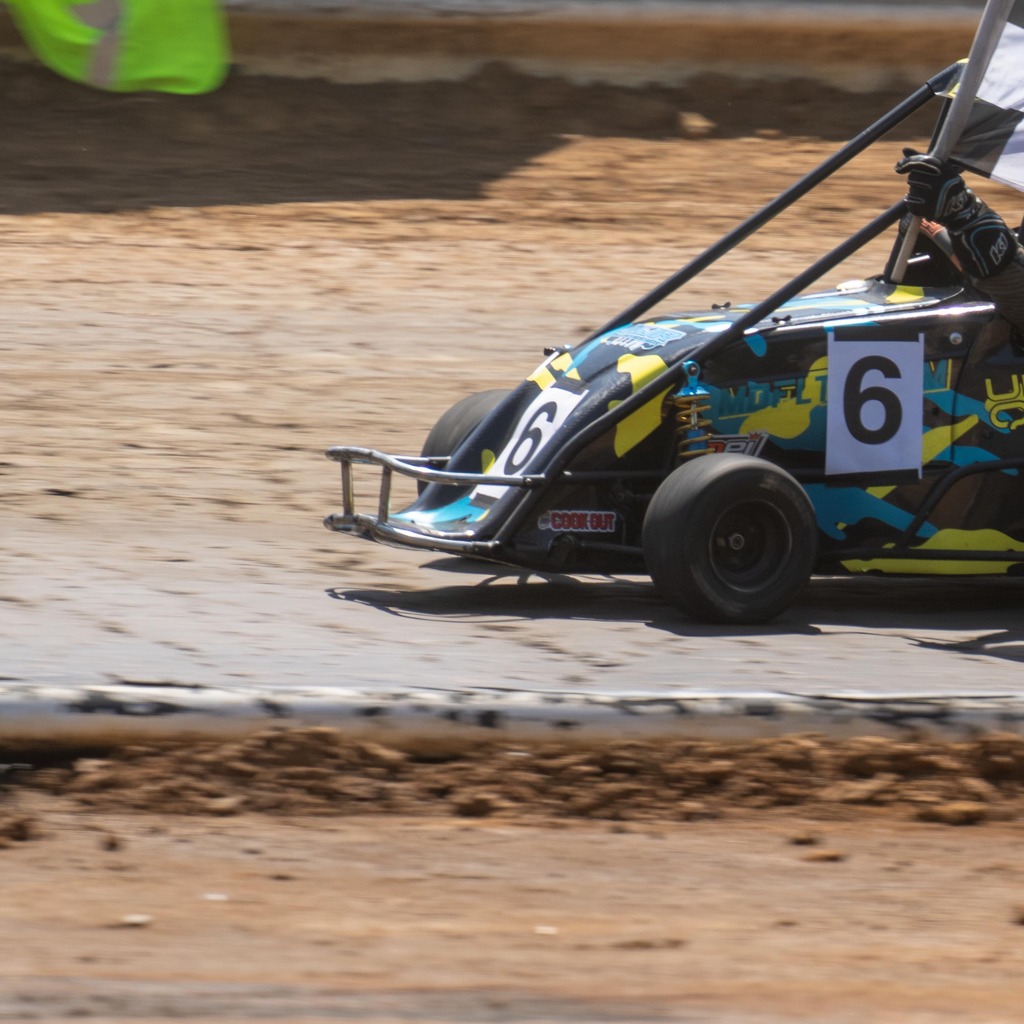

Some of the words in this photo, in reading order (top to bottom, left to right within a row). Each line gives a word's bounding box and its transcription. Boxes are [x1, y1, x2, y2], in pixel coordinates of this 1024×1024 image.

[503, 400, 558, 476] 6
[843, 354, 903, 446] 6
[551, 511, 588, 529] COOK
[589, 512, 615, 531] OUT
